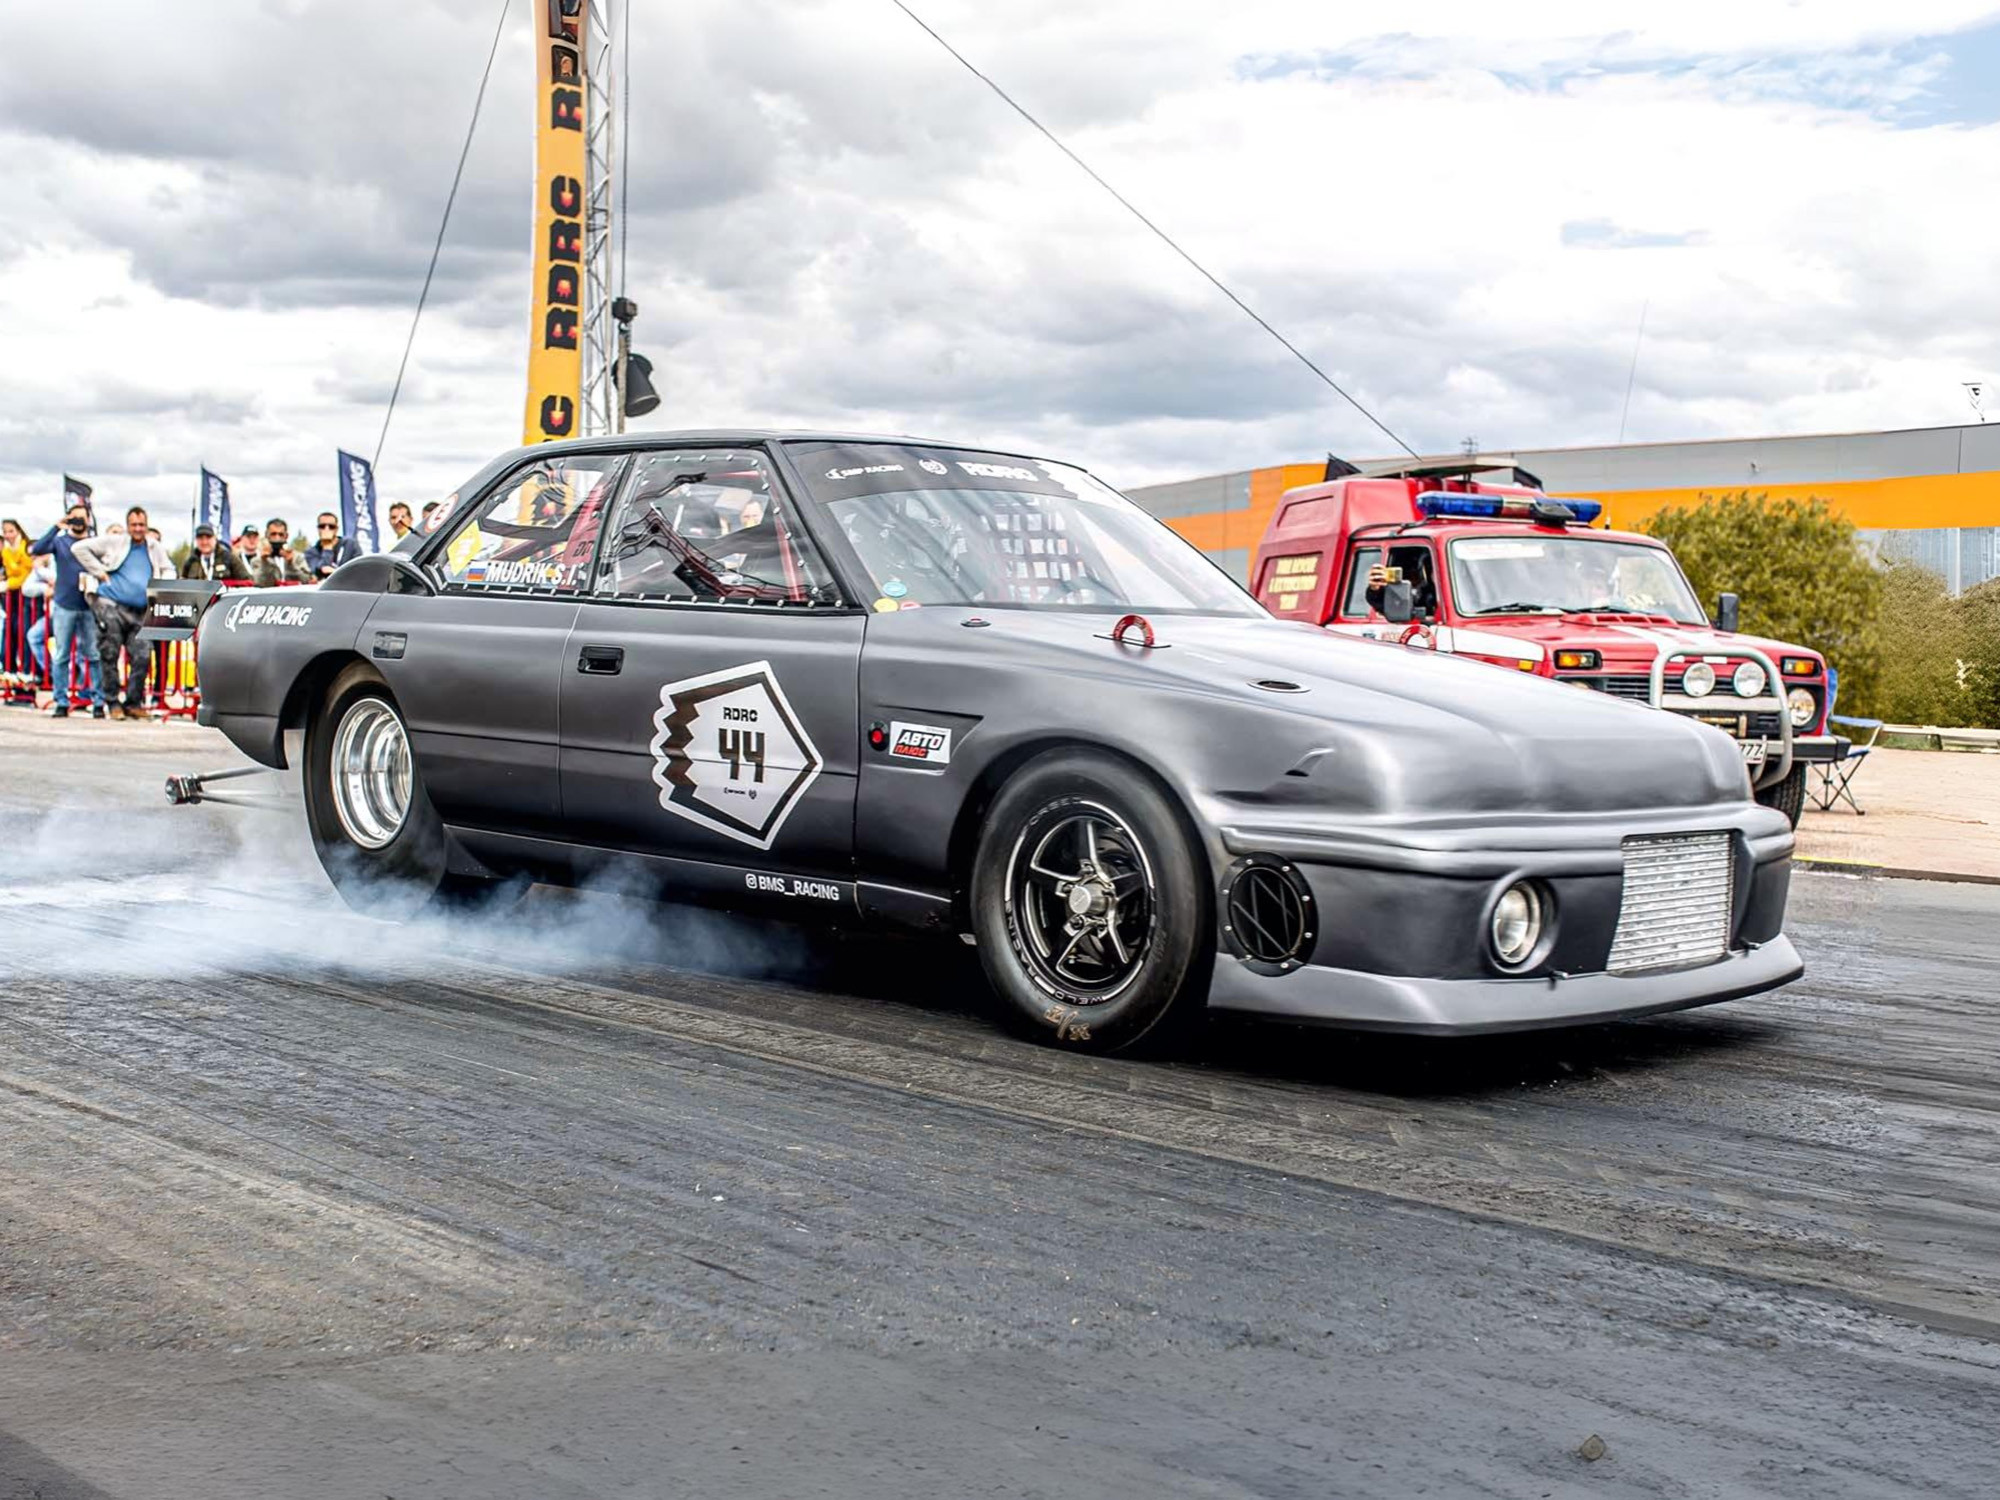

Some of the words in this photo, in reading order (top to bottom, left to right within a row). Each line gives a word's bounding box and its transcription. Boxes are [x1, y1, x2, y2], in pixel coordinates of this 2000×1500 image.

[545, 175, 582, 350] RDRC
[350, 460, 373, 529] RACING
[485, 561, 551, 584] MUDRIK
[238, 605, 266, 624] SMP
[261, 605, 313, 627] RACING
[723, 706, 758, 722] RDRC
[898, 731, 944, 749] АВТО
[718, 728, 765, 783] 44
[745, 873, 840, 901] @BMS_RACING
[1054, 990, 1104, 1005] WELD
